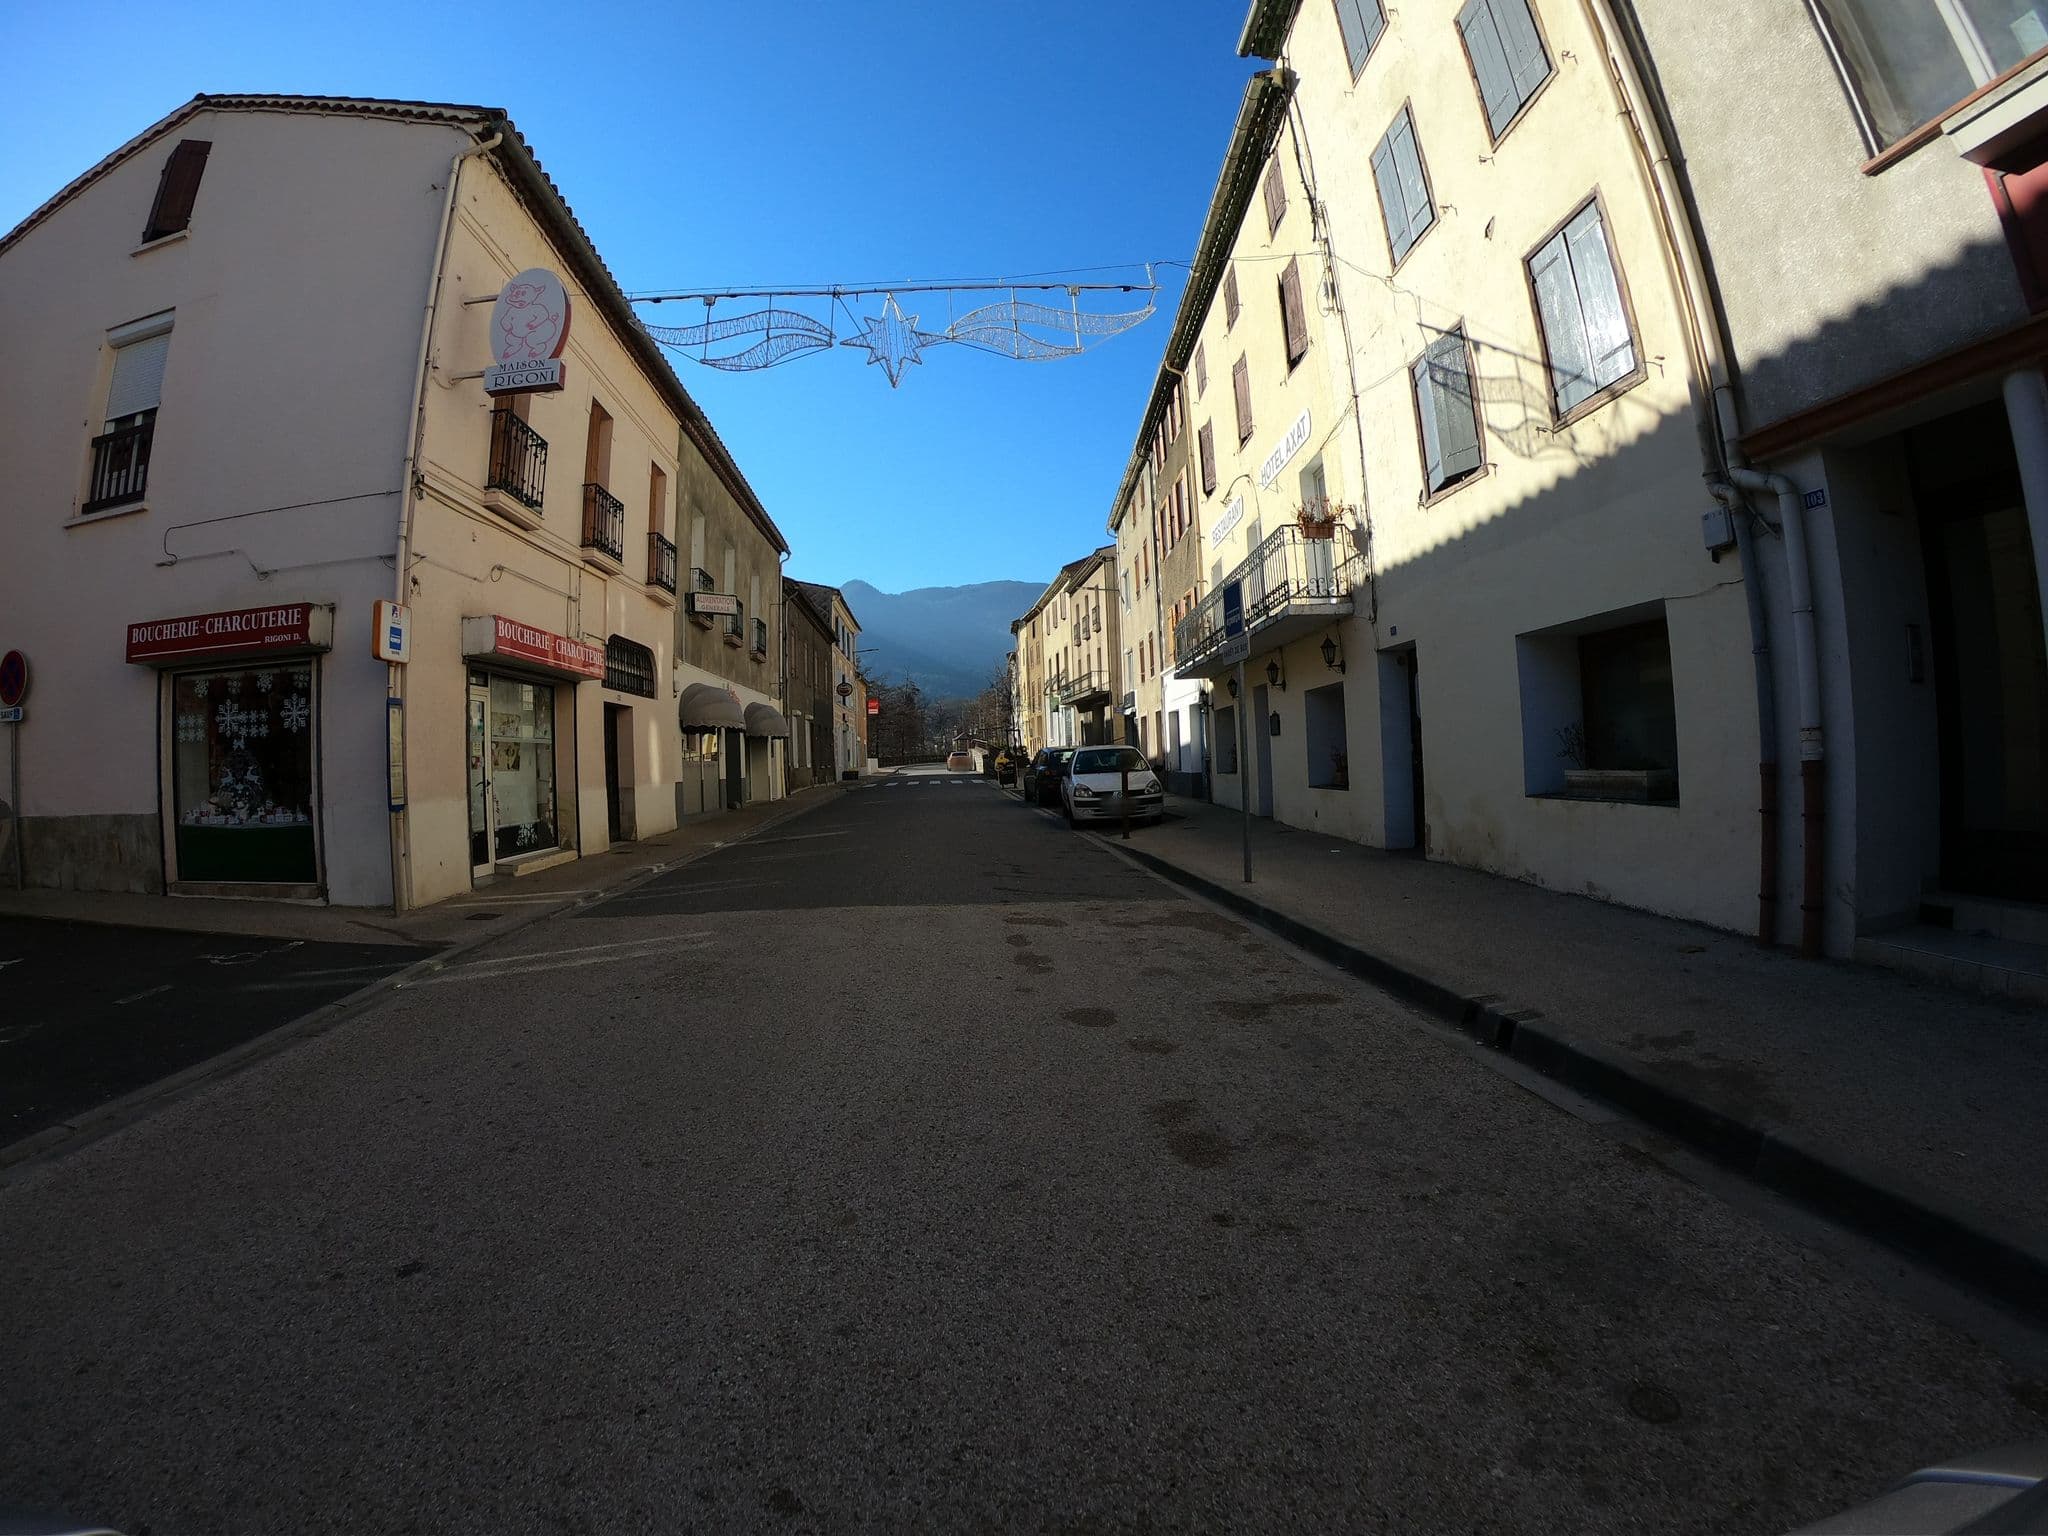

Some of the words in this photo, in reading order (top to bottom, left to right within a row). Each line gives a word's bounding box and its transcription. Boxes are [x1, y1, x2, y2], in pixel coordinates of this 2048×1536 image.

[500, 360, 545, 372] MAISON
[494, 370, 555, 388] RIGONI
[1260, 447, 1284, 487] HOTEL
[1286, 415, 1307, 455] AXAT
[1806, 491, 1824, 506] 103
[1212, 497, 1242, 543] RESTAURANT
[264, 633, 292, 643] RIGONI
[498, 620, 550, 651] BOUCHERIE
[555, 639, 604, 665] CHARCUTERIE
